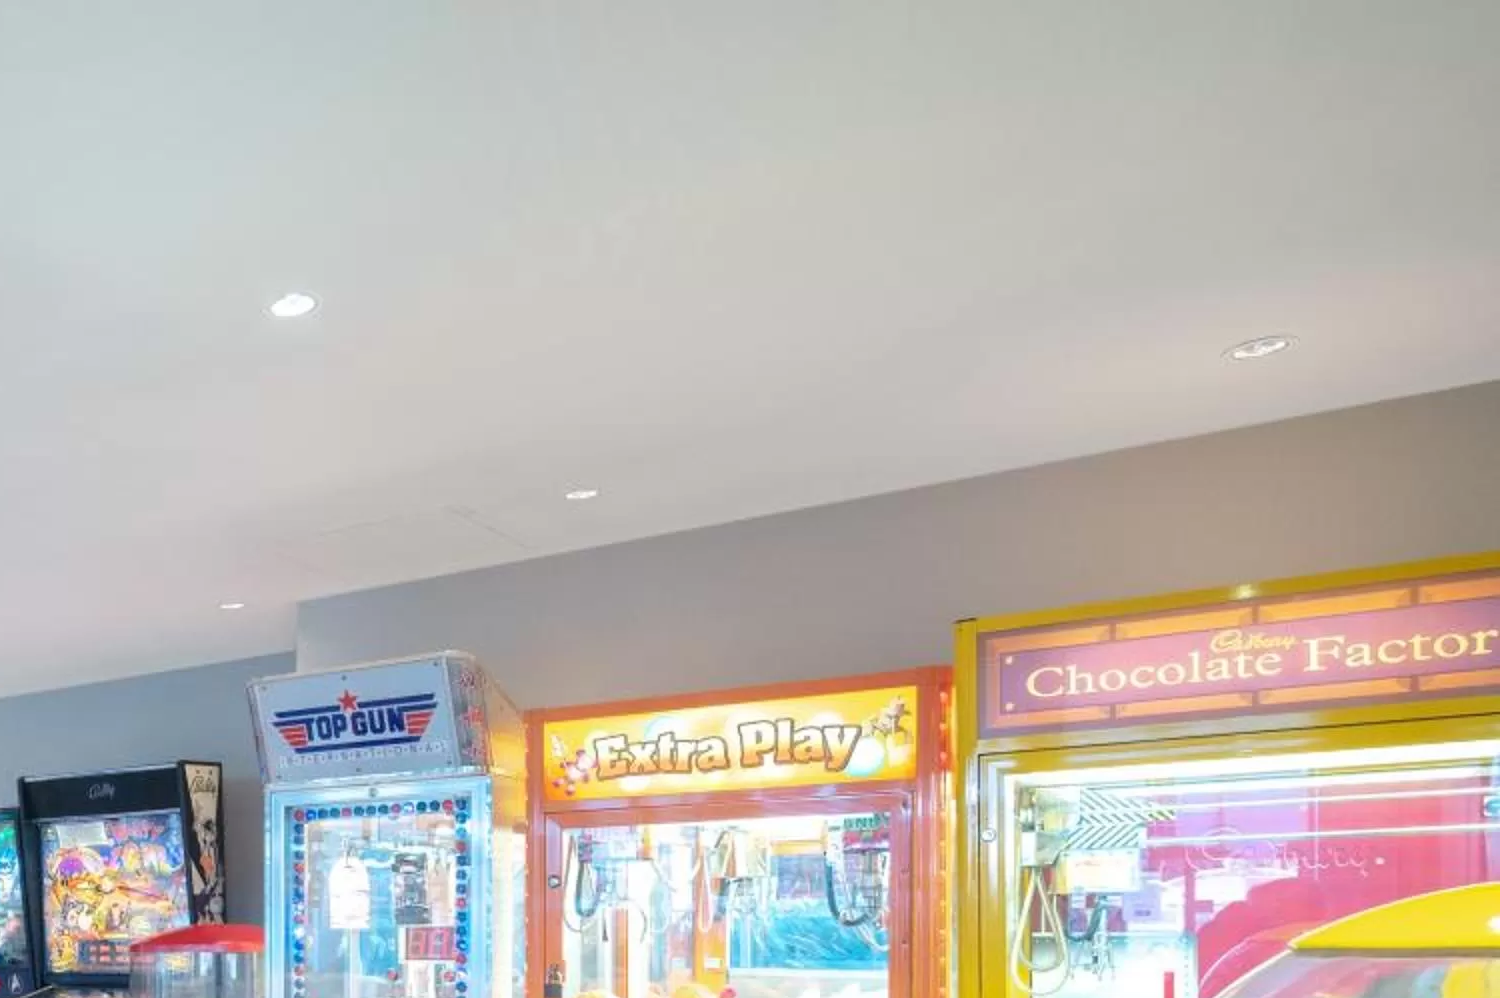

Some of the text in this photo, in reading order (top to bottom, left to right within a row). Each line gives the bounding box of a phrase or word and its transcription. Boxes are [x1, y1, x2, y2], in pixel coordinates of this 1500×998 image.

[1025, 628, 1499, 699] Chocolate Factor
[1209, 628, 1297, 656] Cadbury
[303, 708, 406, 742] TOP GUN
[594, 717, 862, 781] Extra Play
